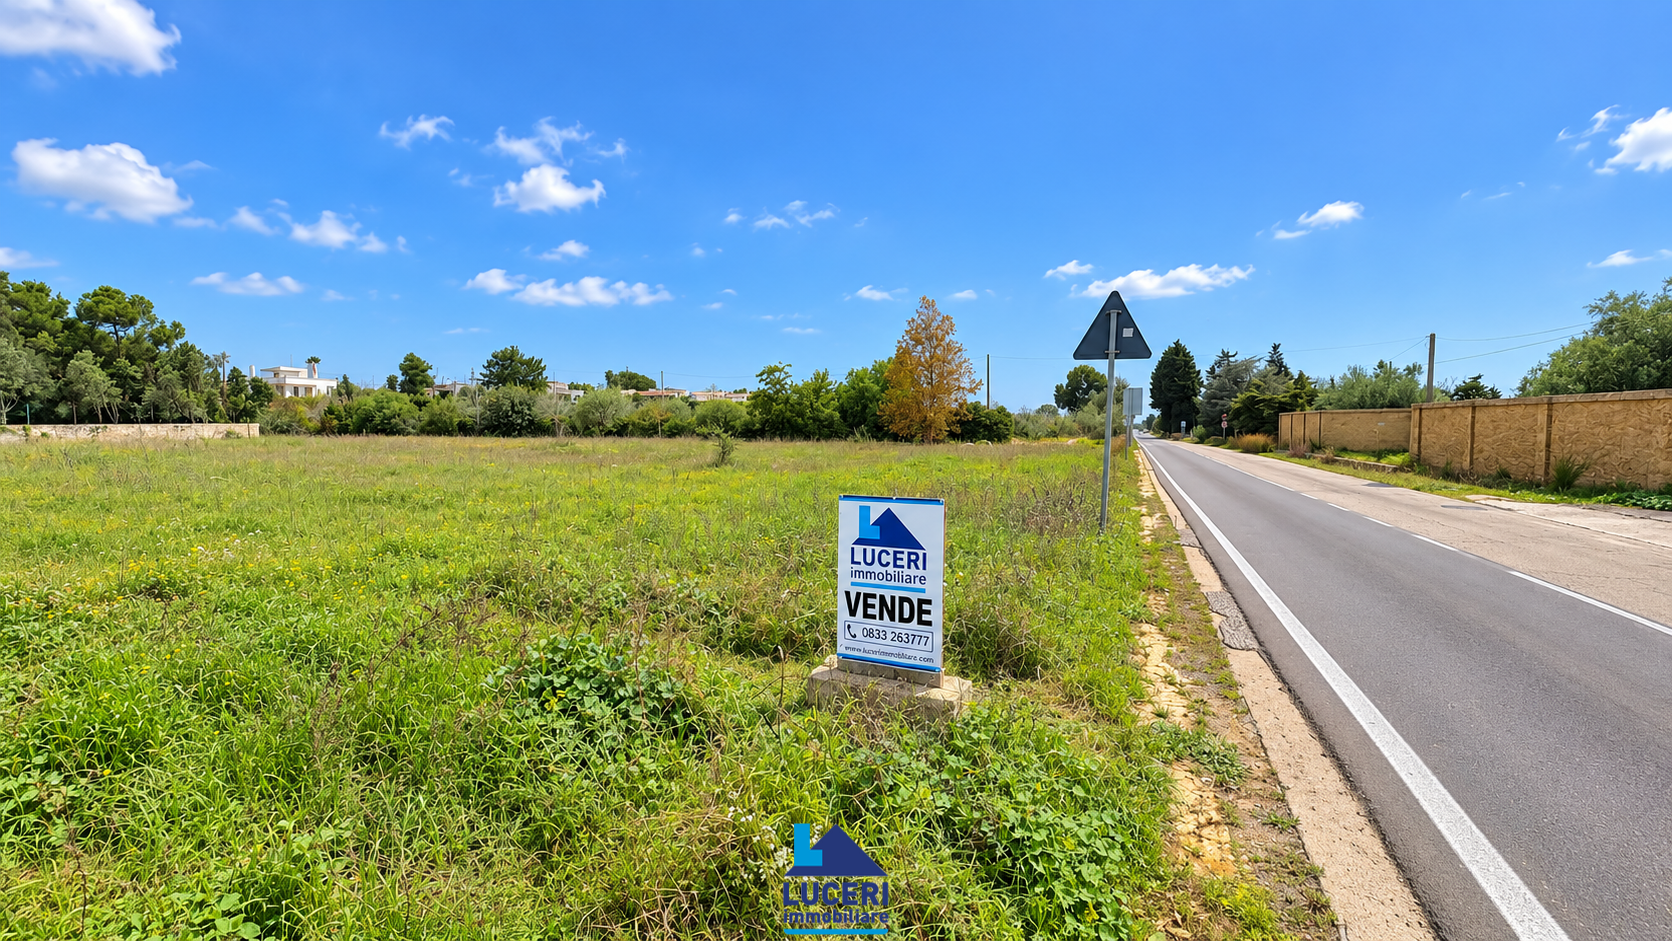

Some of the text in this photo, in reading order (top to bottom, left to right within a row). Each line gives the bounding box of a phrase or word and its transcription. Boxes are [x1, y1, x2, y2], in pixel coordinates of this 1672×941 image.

[851, 547, 927, 570] LUCERI
[850, 566, 927, 585] immobiliare
[844, 590, 933, 627] VENDE
[862, 627, 930, 646] 0833 263777
